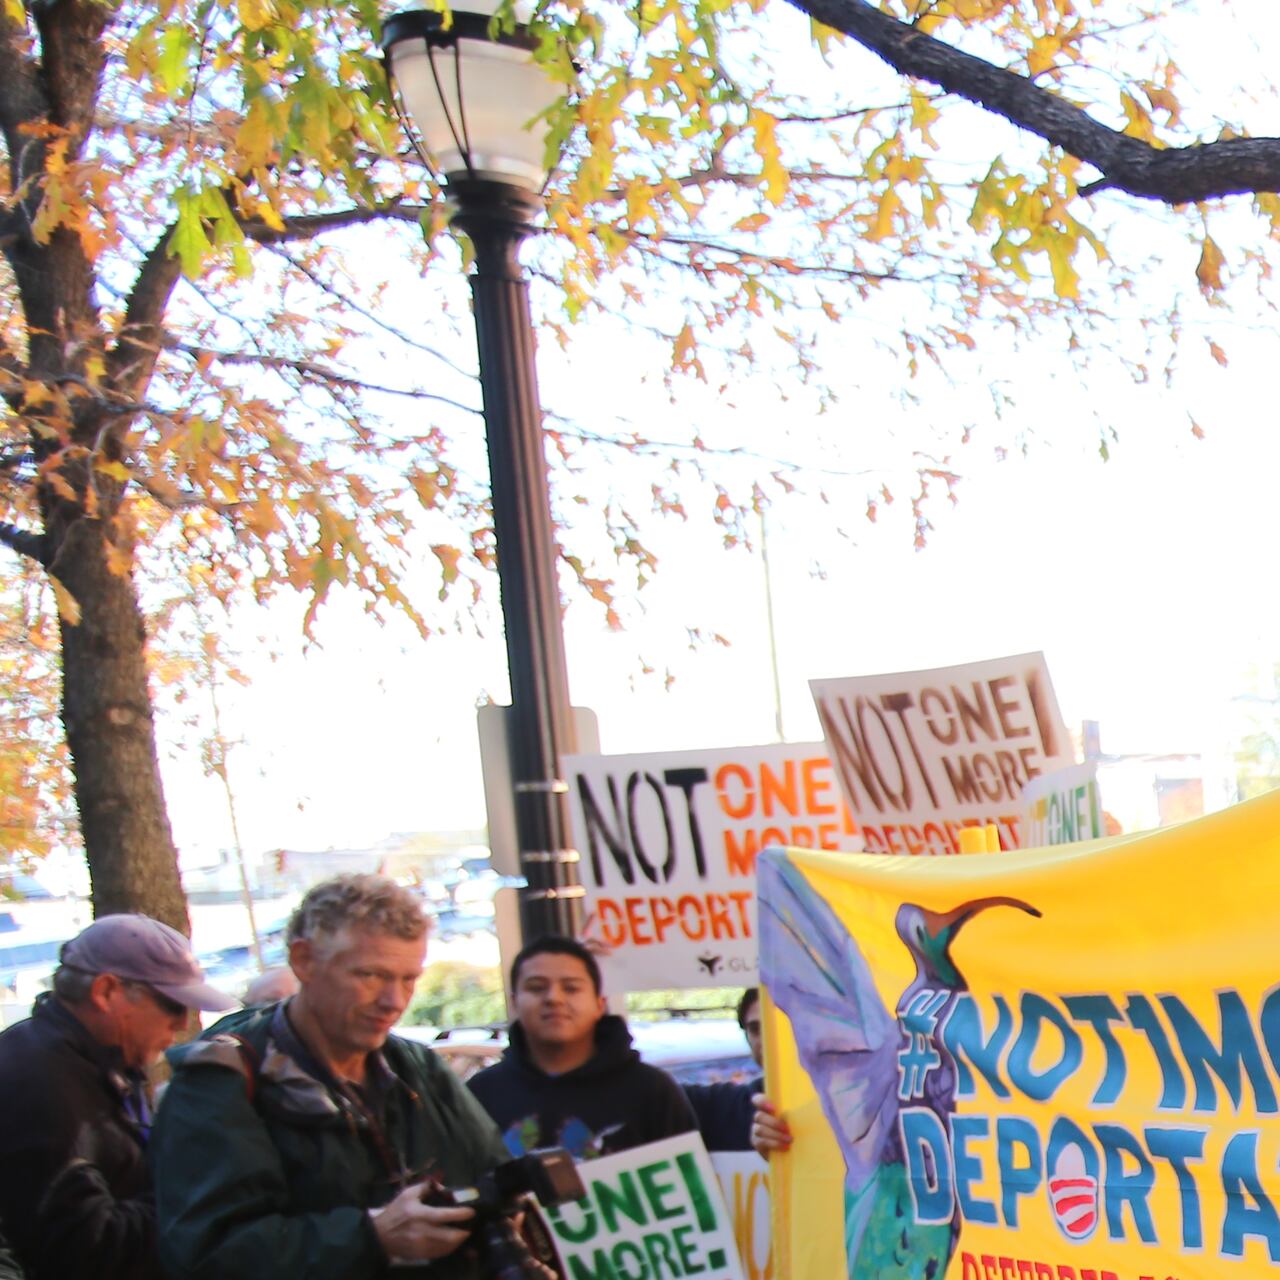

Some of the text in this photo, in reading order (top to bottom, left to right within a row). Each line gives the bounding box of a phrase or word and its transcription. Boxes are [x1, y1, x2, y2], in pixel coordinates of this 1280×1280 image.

[818, 692, 940, 813] NOT
[576, 757, 858, 887] NOT ONE
